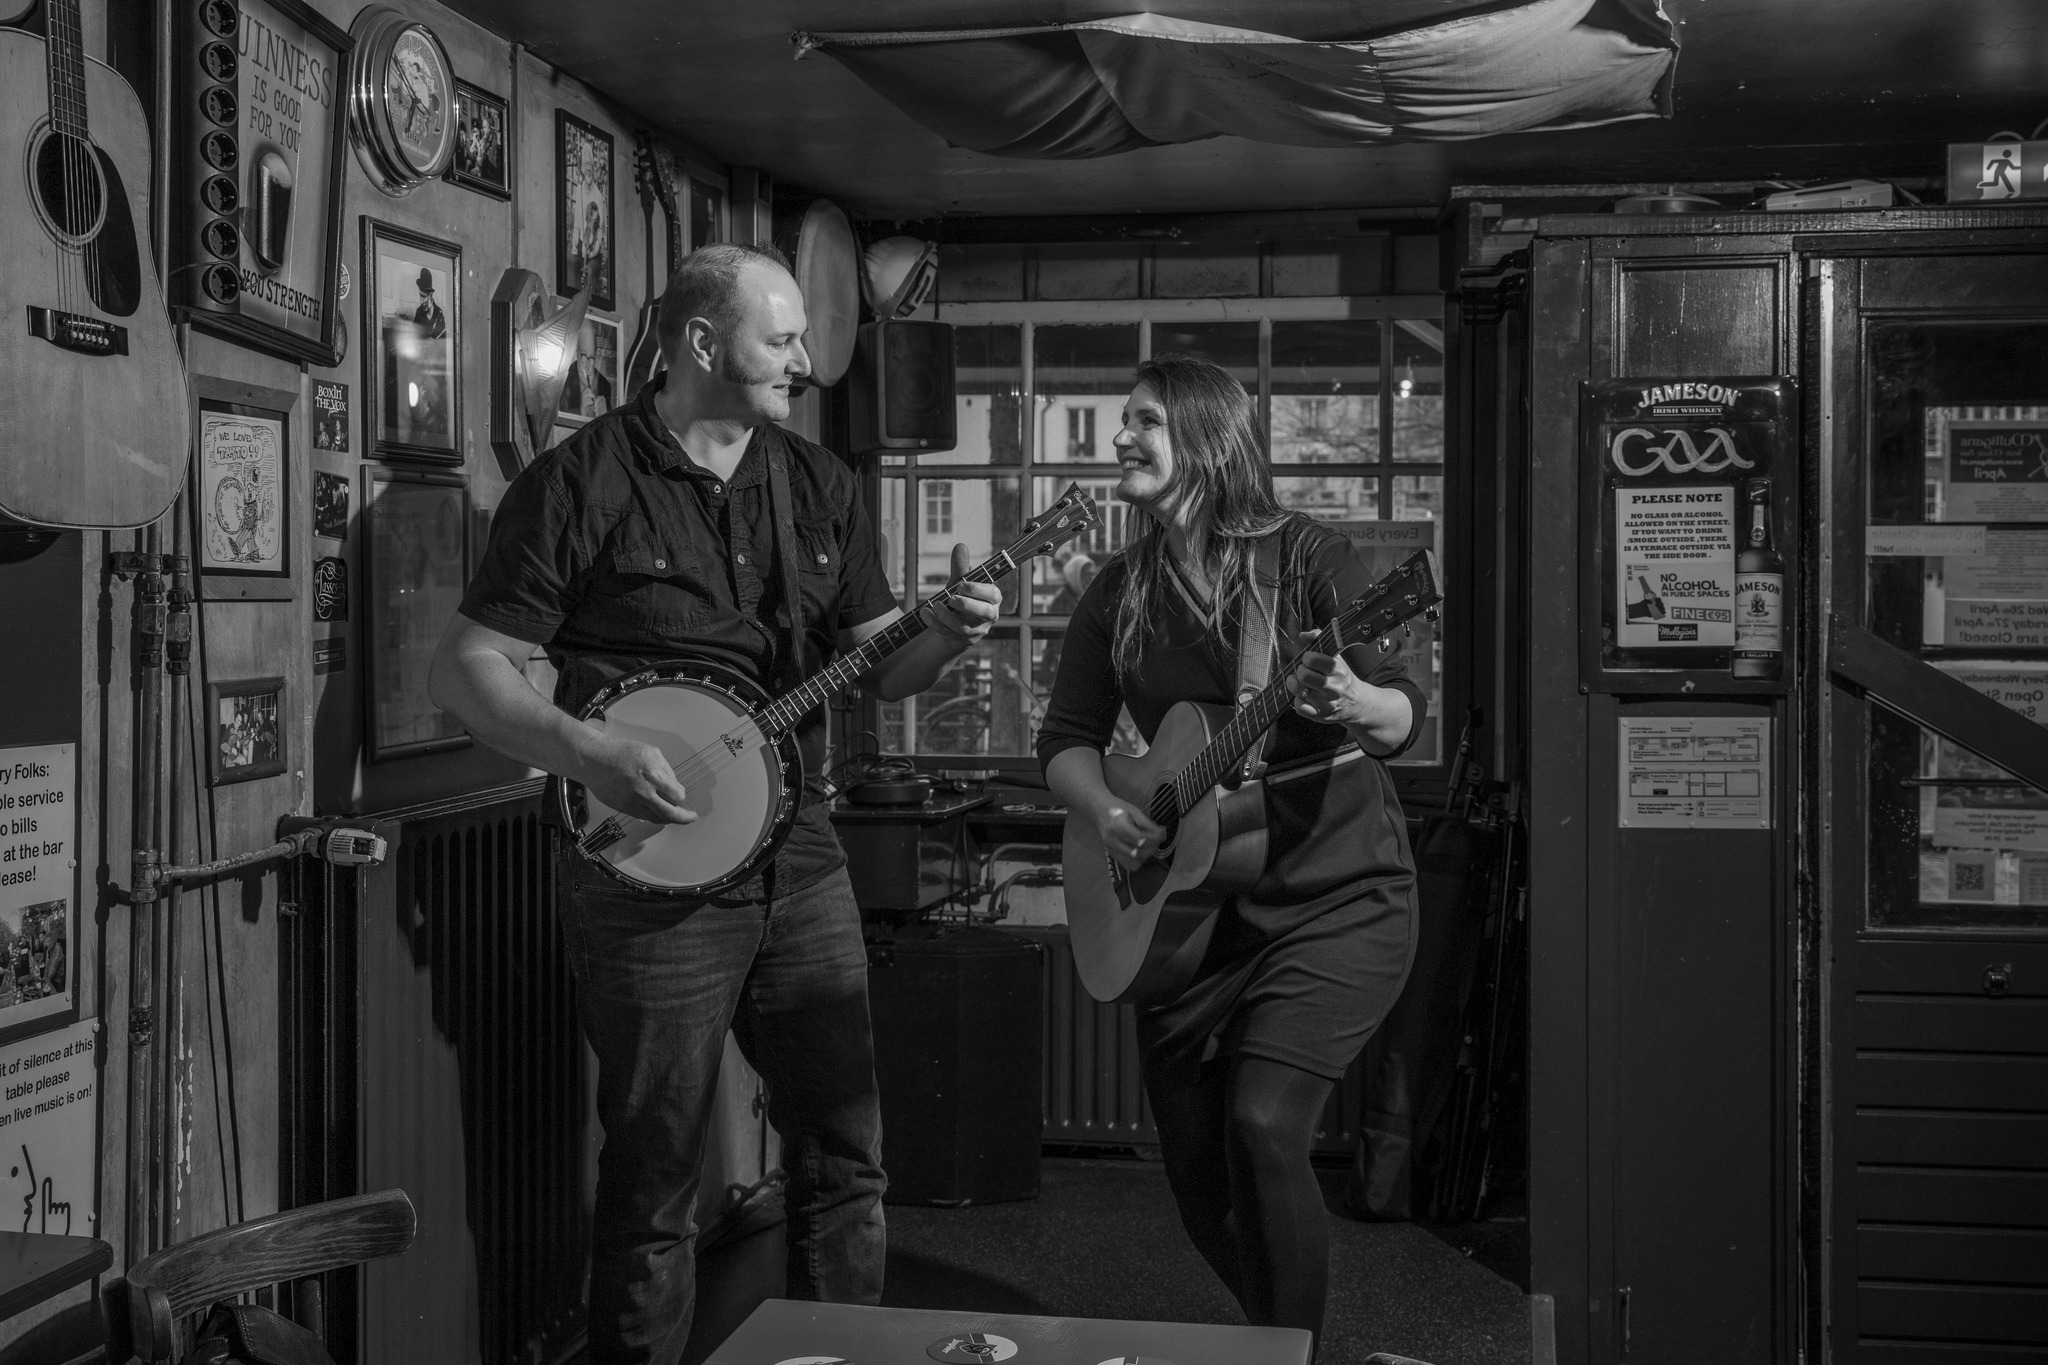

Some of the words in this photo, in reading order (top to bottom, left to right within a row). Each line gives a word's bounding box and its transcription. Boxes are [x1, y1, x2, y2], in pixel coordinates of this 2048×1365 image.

[239, 9, 333, 110] UINNESS
[253, 74, 268, 103] IS
[273, 89, 302, 123] GOOD
[249, 105, 272, 139] FOR
[279, 121, 302, 153] YOU
[266, 279, 321, 321] STRENGTH
[1638, 382, 1739, 408] JAMESON
[1652, 406, 1678, 414] IRISH
[1680, 406, 1723, 414] WHISKEY
[218, 432, 230, 442] WE
[233, 432, 252, 443] LOVE
[1632, 494, 1682, 504] PLEASE
[1686, 494, 1722, 503] NOTE
[1660, 574, 1678, 582] NO
[1661, 580, 1720, 591] ALCOHOL
[1735, 582, 1781, 596] JAMESON
[1673, 608, 1704, 620] FINE
[14, 762, 50, 780] Folks:
[18, 789, 64, 808] service
[12, 816, 38, 834] bills
[4, 846, 16, 862] at
[19, 844, 39, 859] the
[42, 840, 64, 856] bar
[0, 865, 36, 886] ease!
[8, 1058, 21, 1074] of
[24, 1050, 61, 1070] silence
[64, 1043, 73, 1058] at
[75, 1038, 93, 1054] this
[6, 1081, 34, 1100] table
[36, 1071, 70, 1095] please
[0, 1114, 12, 1127] en
[14, 1107, 32, 1122] live
[34, 1095, 64, 1115] music
[67, 1091, 74, 1104] is
[77, 1084, 92, 1100] on!
